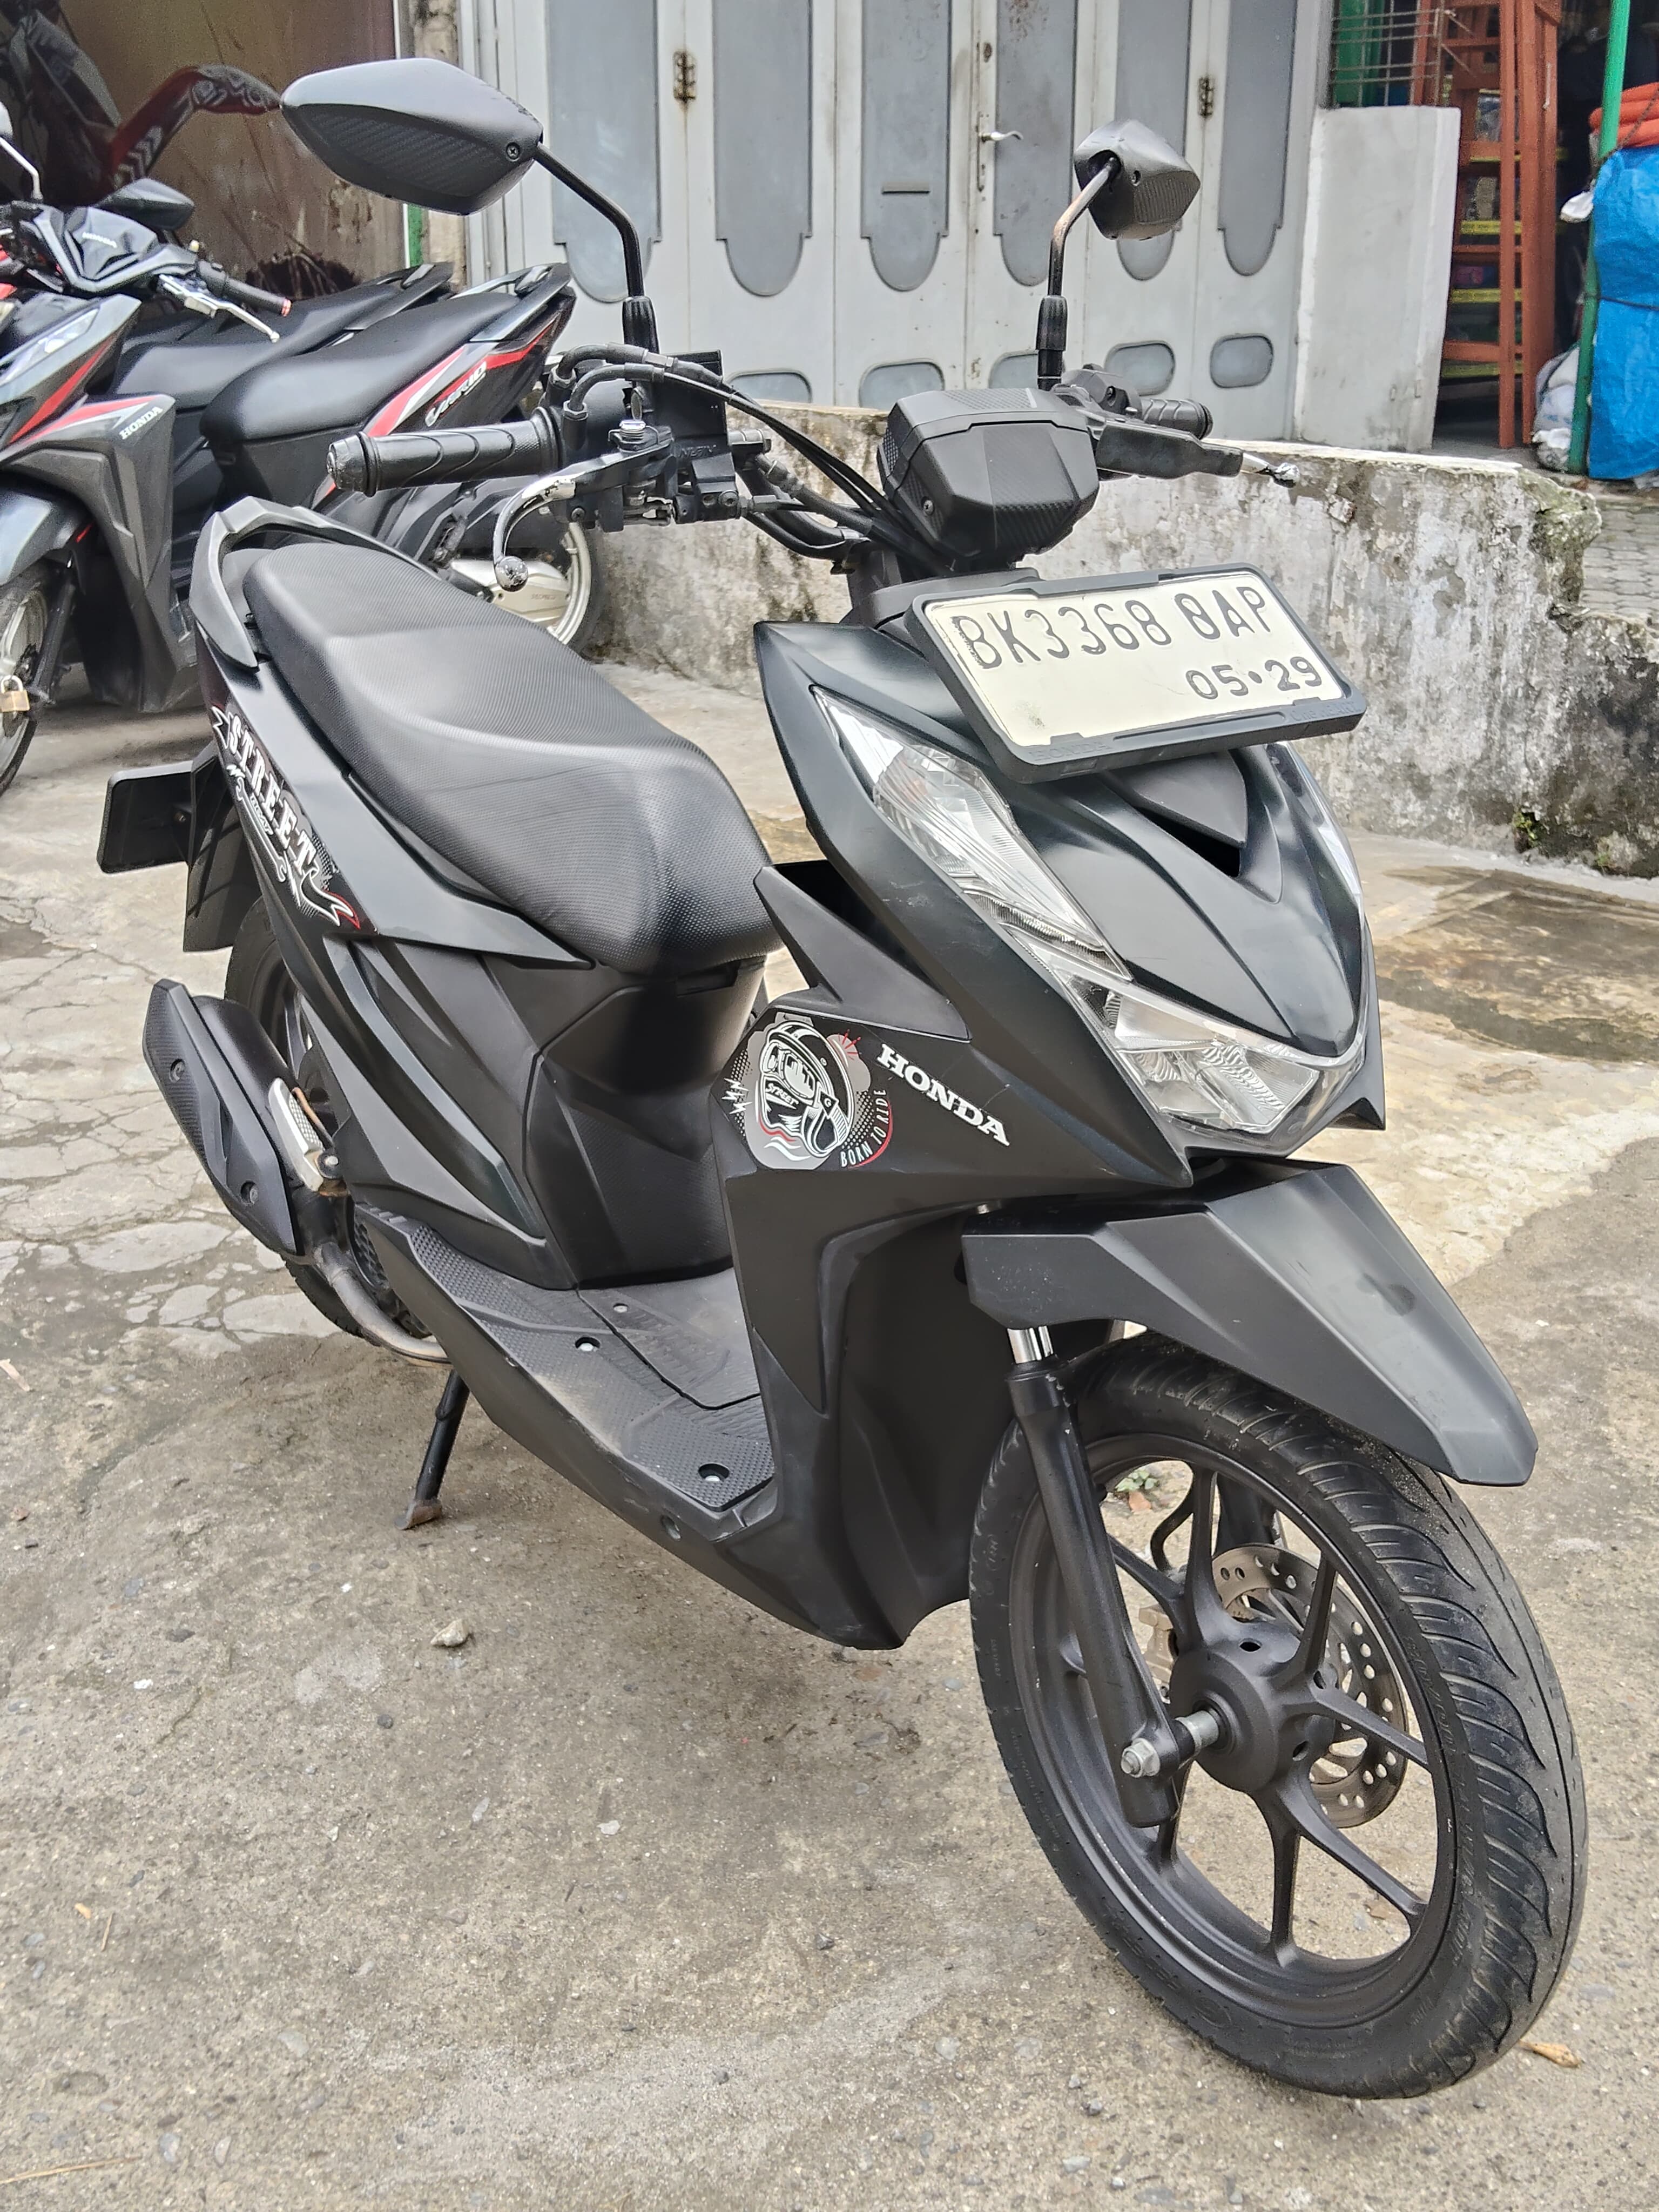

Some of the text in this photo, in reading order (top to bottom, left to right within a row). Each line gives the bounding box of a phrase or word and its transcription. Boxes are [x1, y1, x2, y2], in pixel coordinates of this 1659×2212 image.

[119, 406, 163, 440] HONDA
[228, 716, 318, 875] STREET
[765, 1083, 799, 1105] STREET
[840, 1090, 889, 1168] BORN TO RIDE
[876, 1043, 1010, 1147] HONDA
